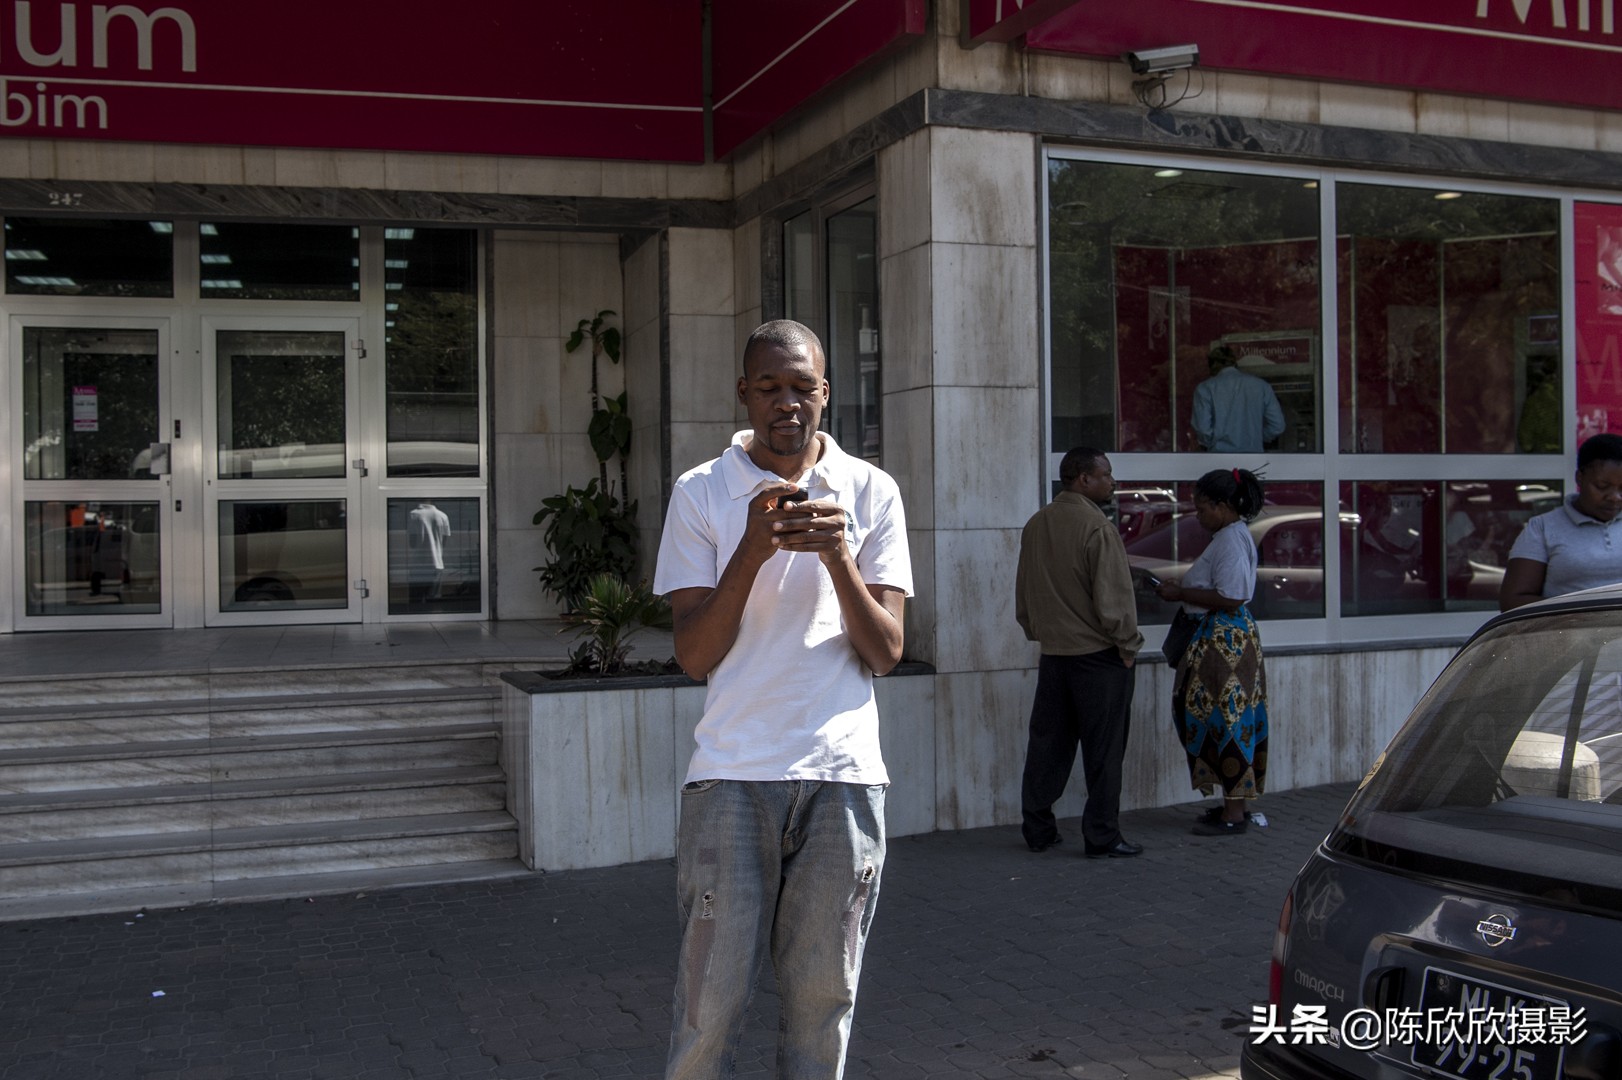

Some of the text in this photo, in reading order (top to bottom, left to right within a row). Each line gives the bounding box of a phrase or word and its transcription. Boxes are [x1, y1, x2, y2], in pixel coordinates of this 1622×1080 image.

[0, 0, 198, 73] um
[48, 192, 84, 206] 247
[1479, 923, 1512, 937] NISSAN
